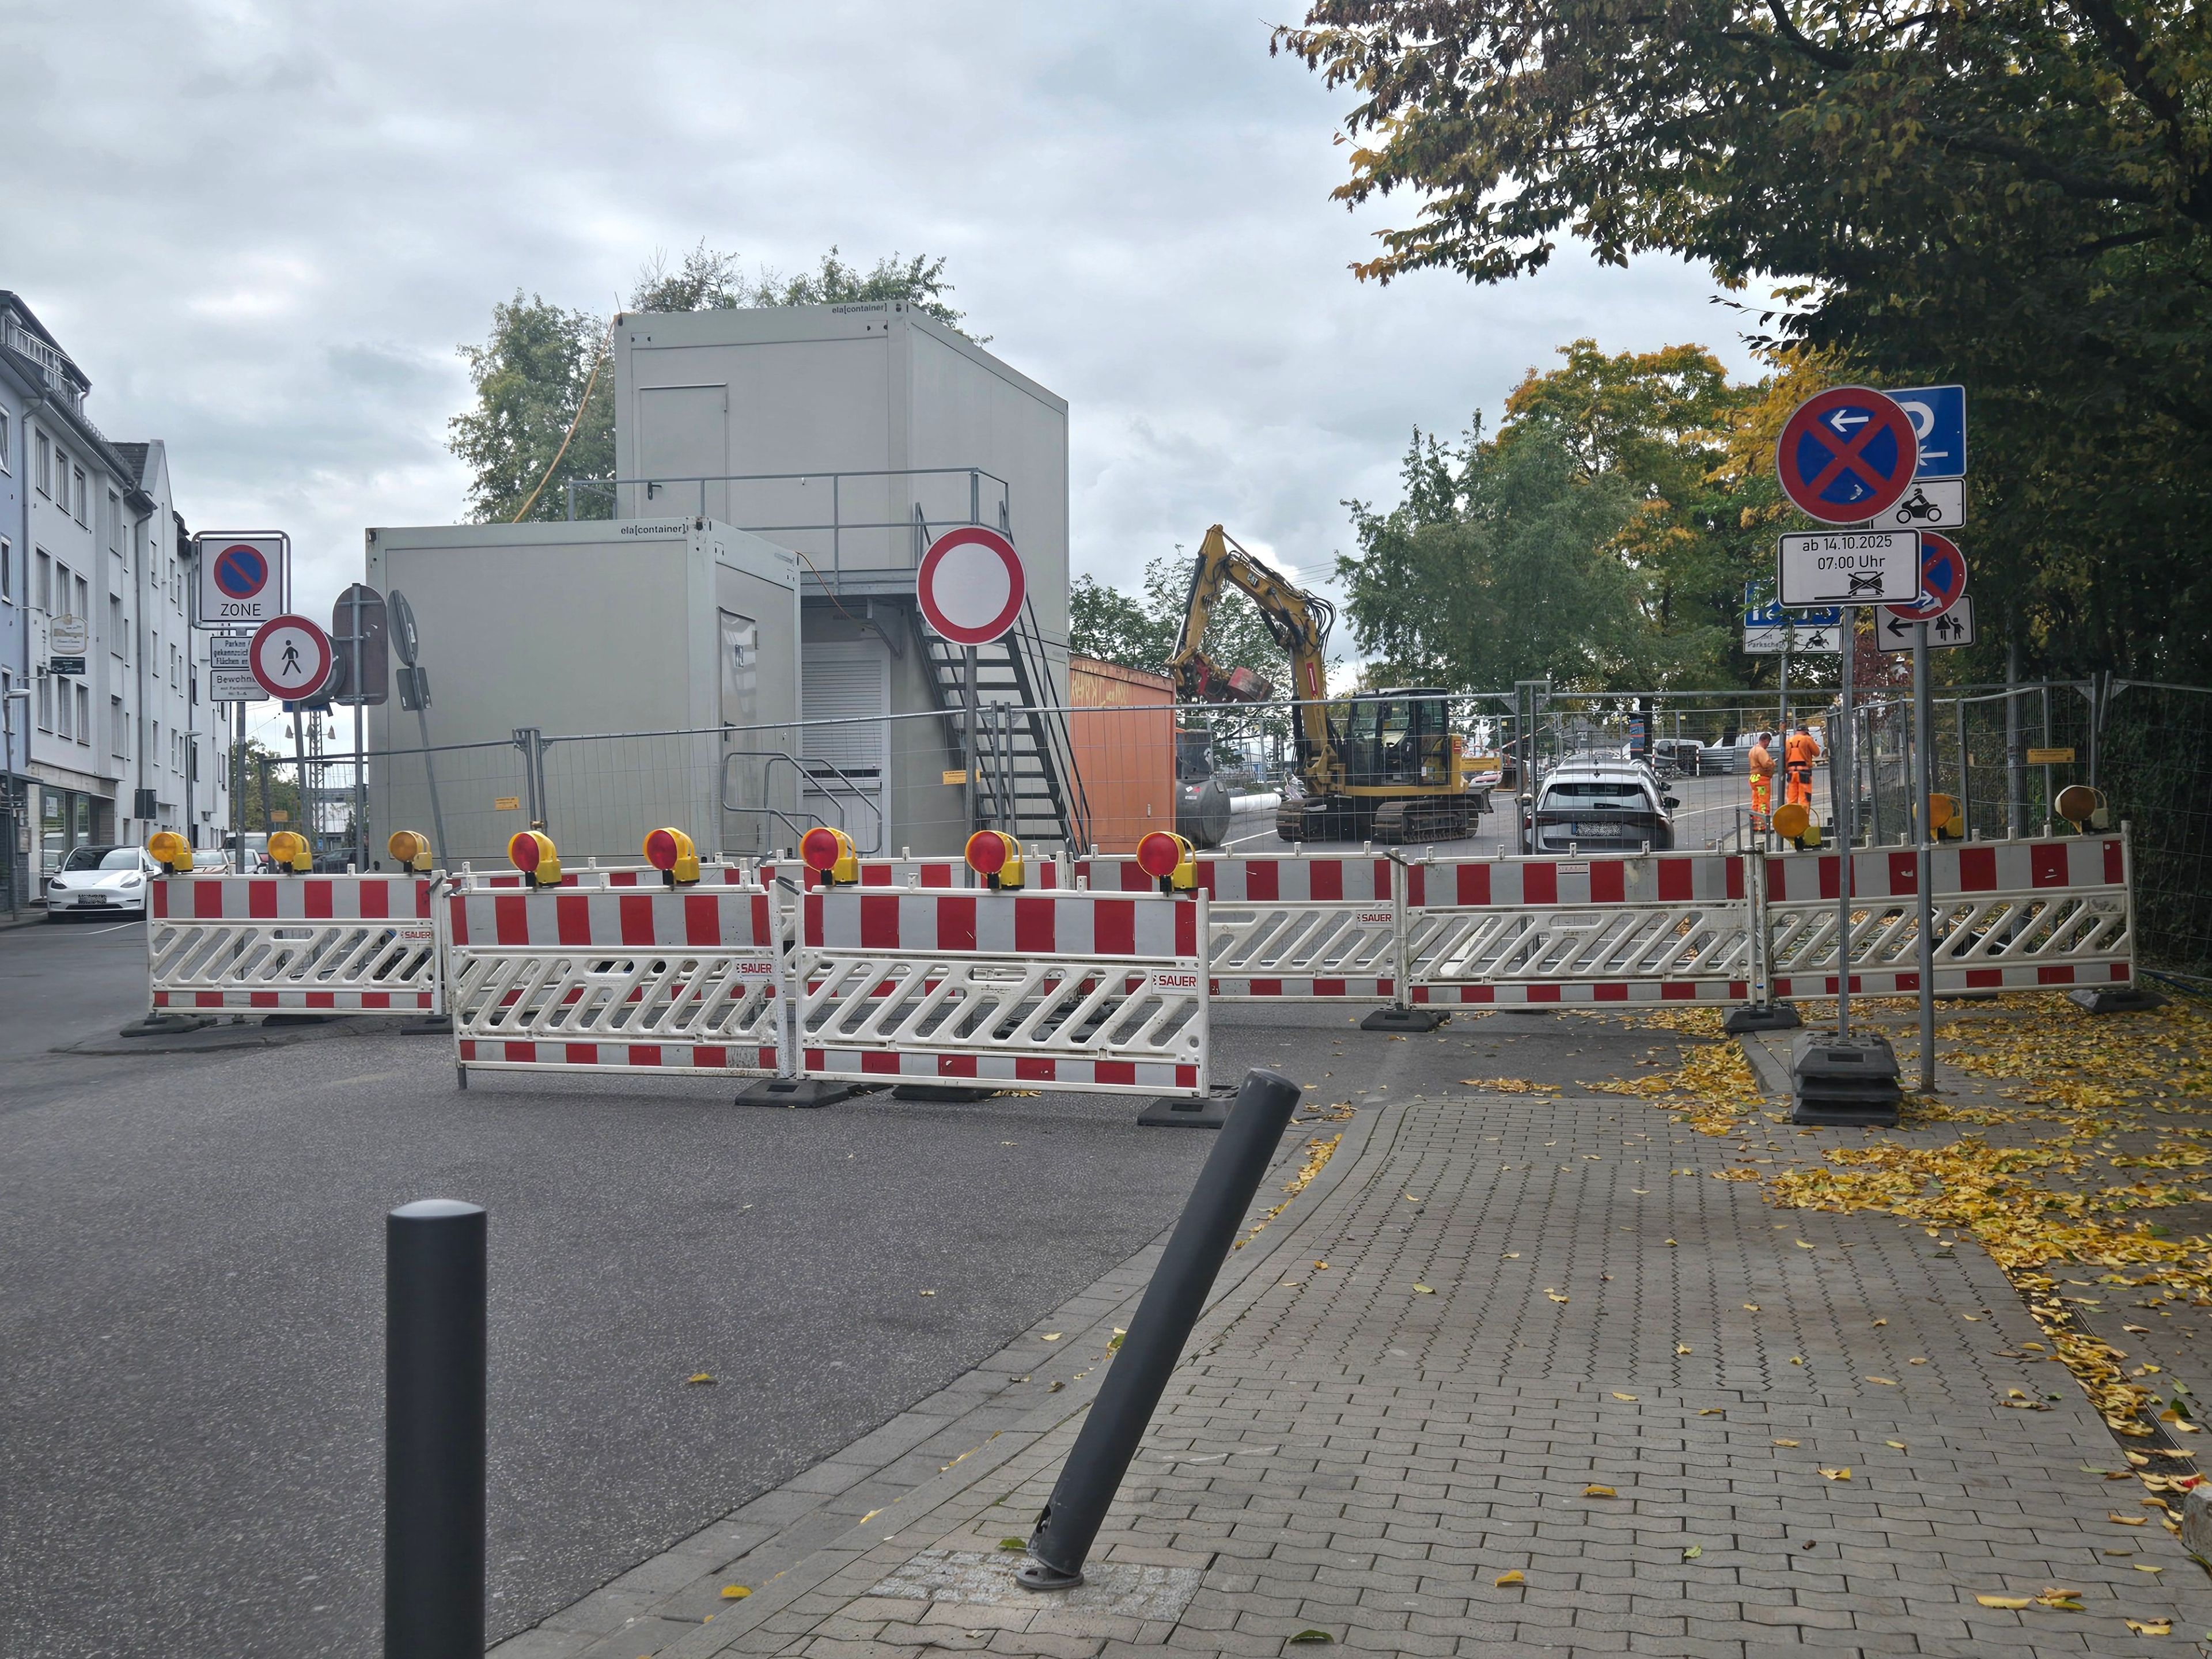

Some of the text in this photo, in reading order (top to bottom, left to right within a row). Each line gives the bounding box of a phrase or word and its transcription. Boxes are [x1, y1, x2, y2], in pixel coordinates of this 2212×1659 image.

[1802, 535, 1892, 551] ab 14.10.2025
[1817, 555, 1885, 570] 07:00 Uhr
[1247, 573, 1259, 586] CAT
[221, 604, 261, 616] ZONE
[1362, 914, 1392, 922] SAUER
[405, 931, 431, 939] SAUER
[741, 963, 772, 974] SAUER
[1158, 975, 1196, 987] SAUER
